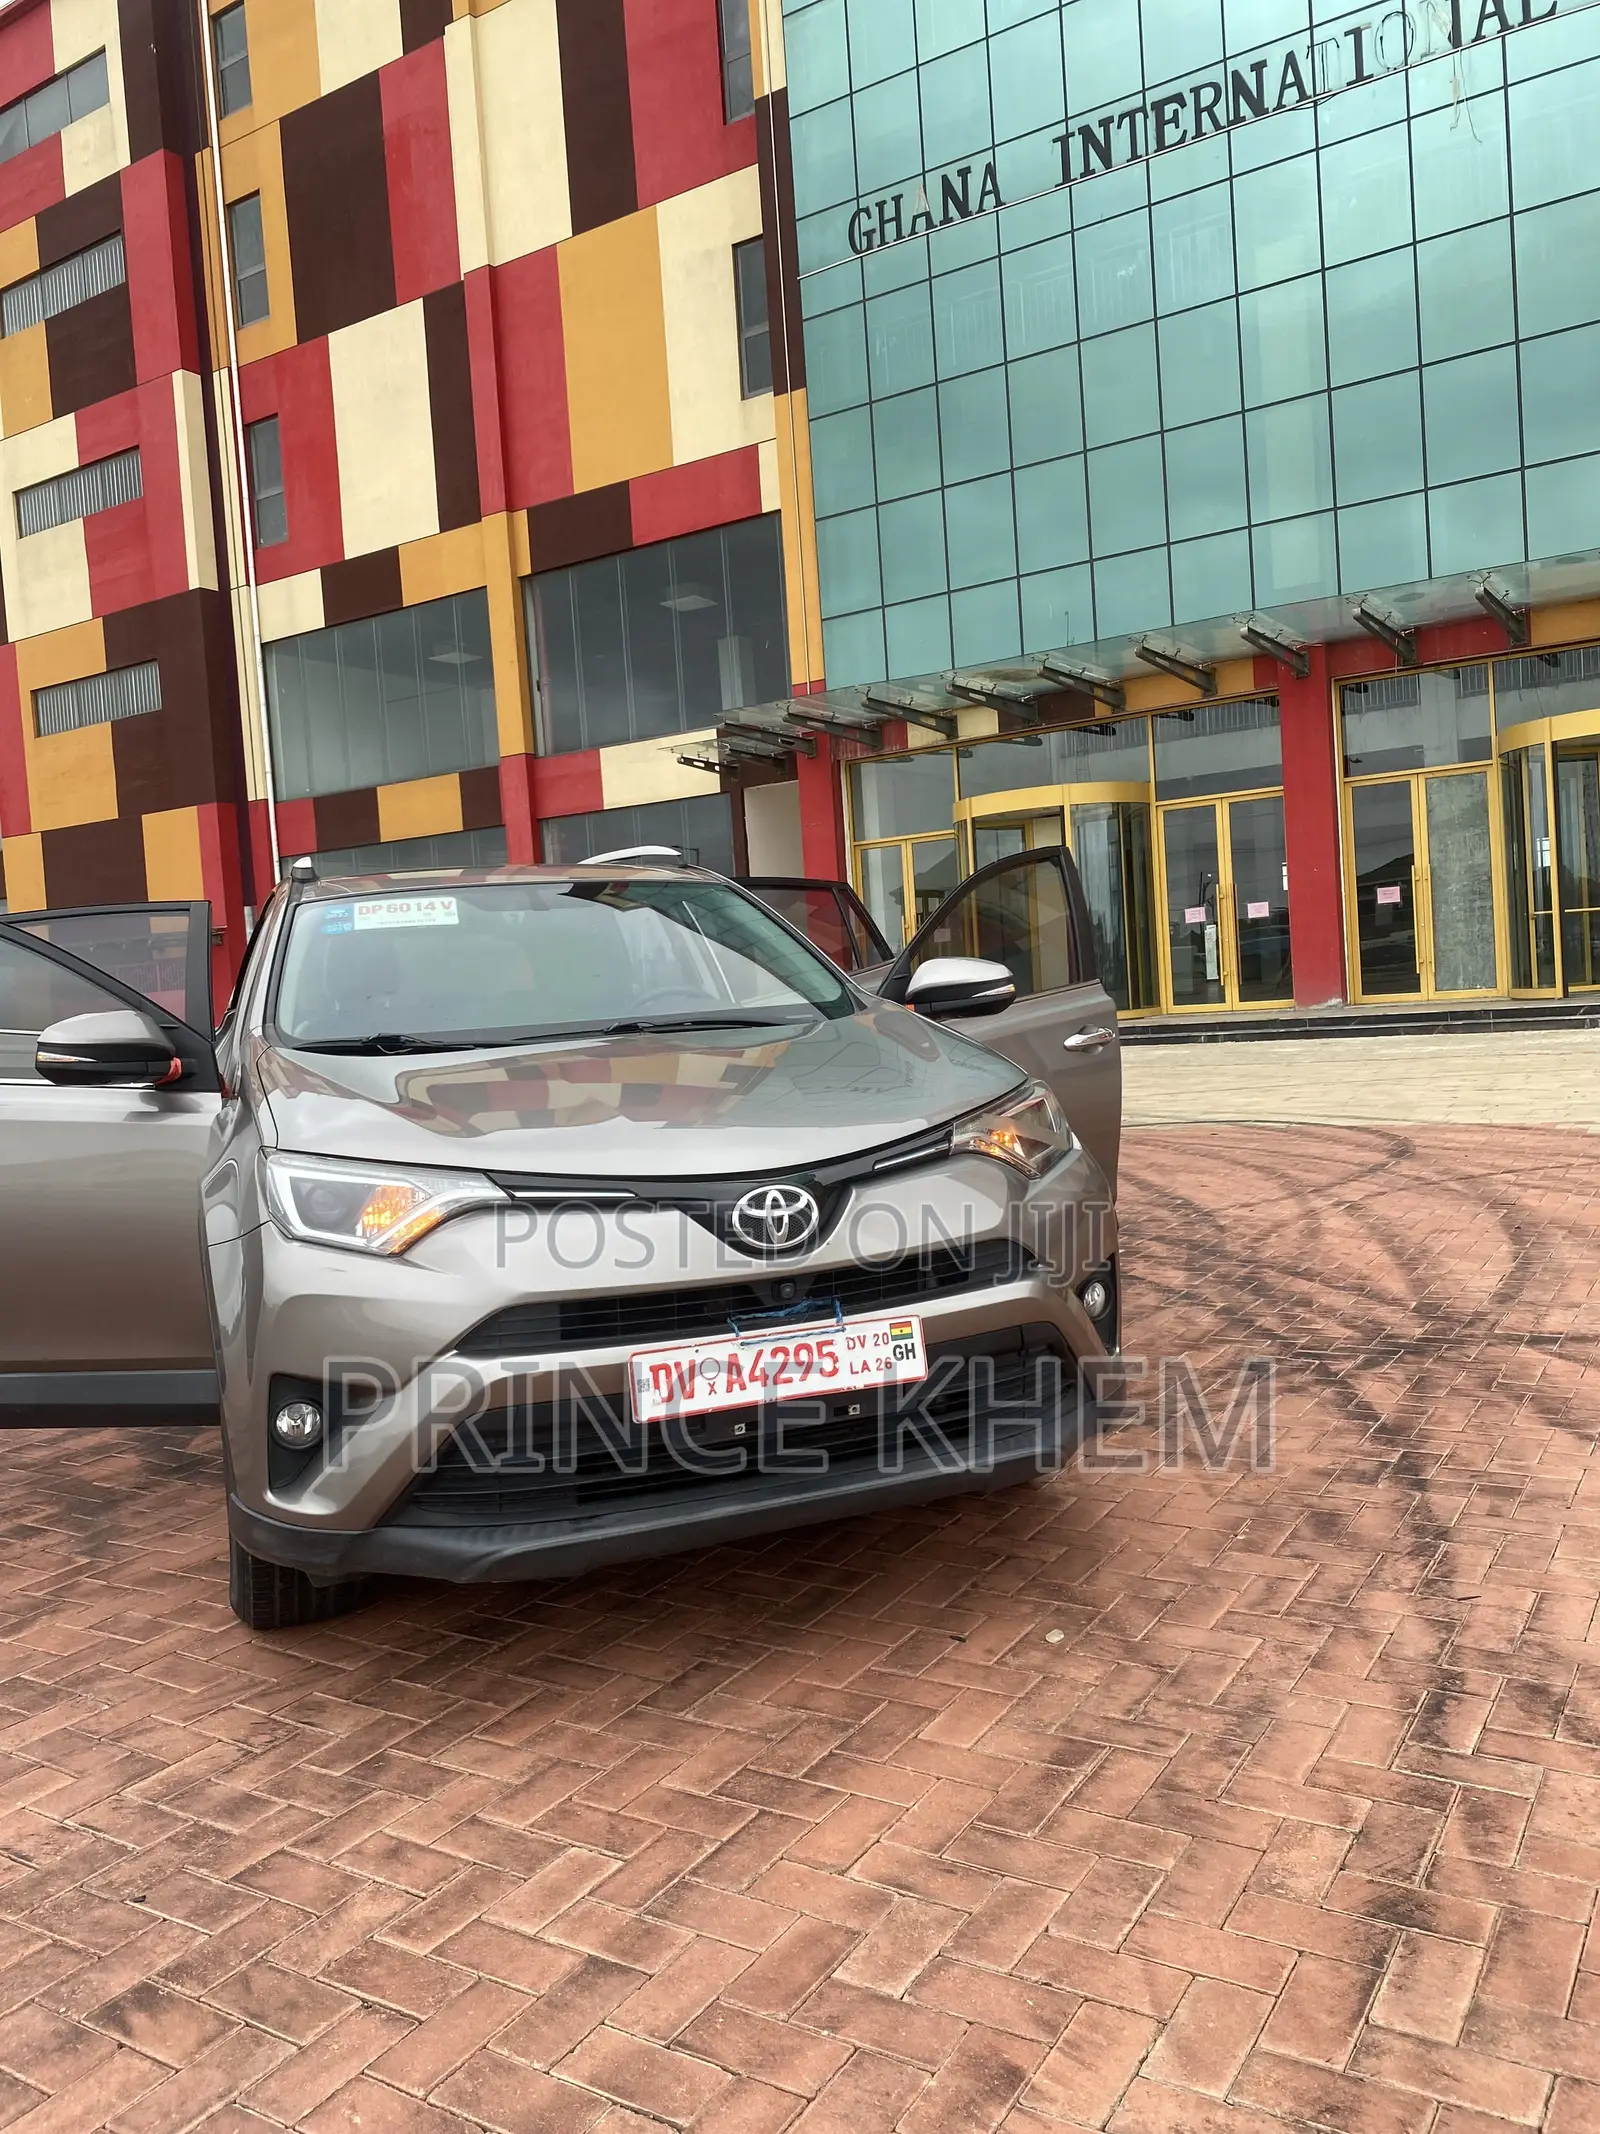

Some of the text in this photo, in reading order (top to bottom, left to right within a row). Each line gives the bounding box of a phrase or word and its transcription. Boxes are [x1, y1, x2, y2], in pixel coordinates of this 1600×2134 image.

[848, 161, 1006, 255] GHANA
[845, 1332, 889, 1350] DV 20
[893, 1343, 916, 1361] GH
[649, 1359, 696, 1403] DV
[726, 1339, 839, 1393] A4295
[849, 1357, 892, 1375] LA 26
